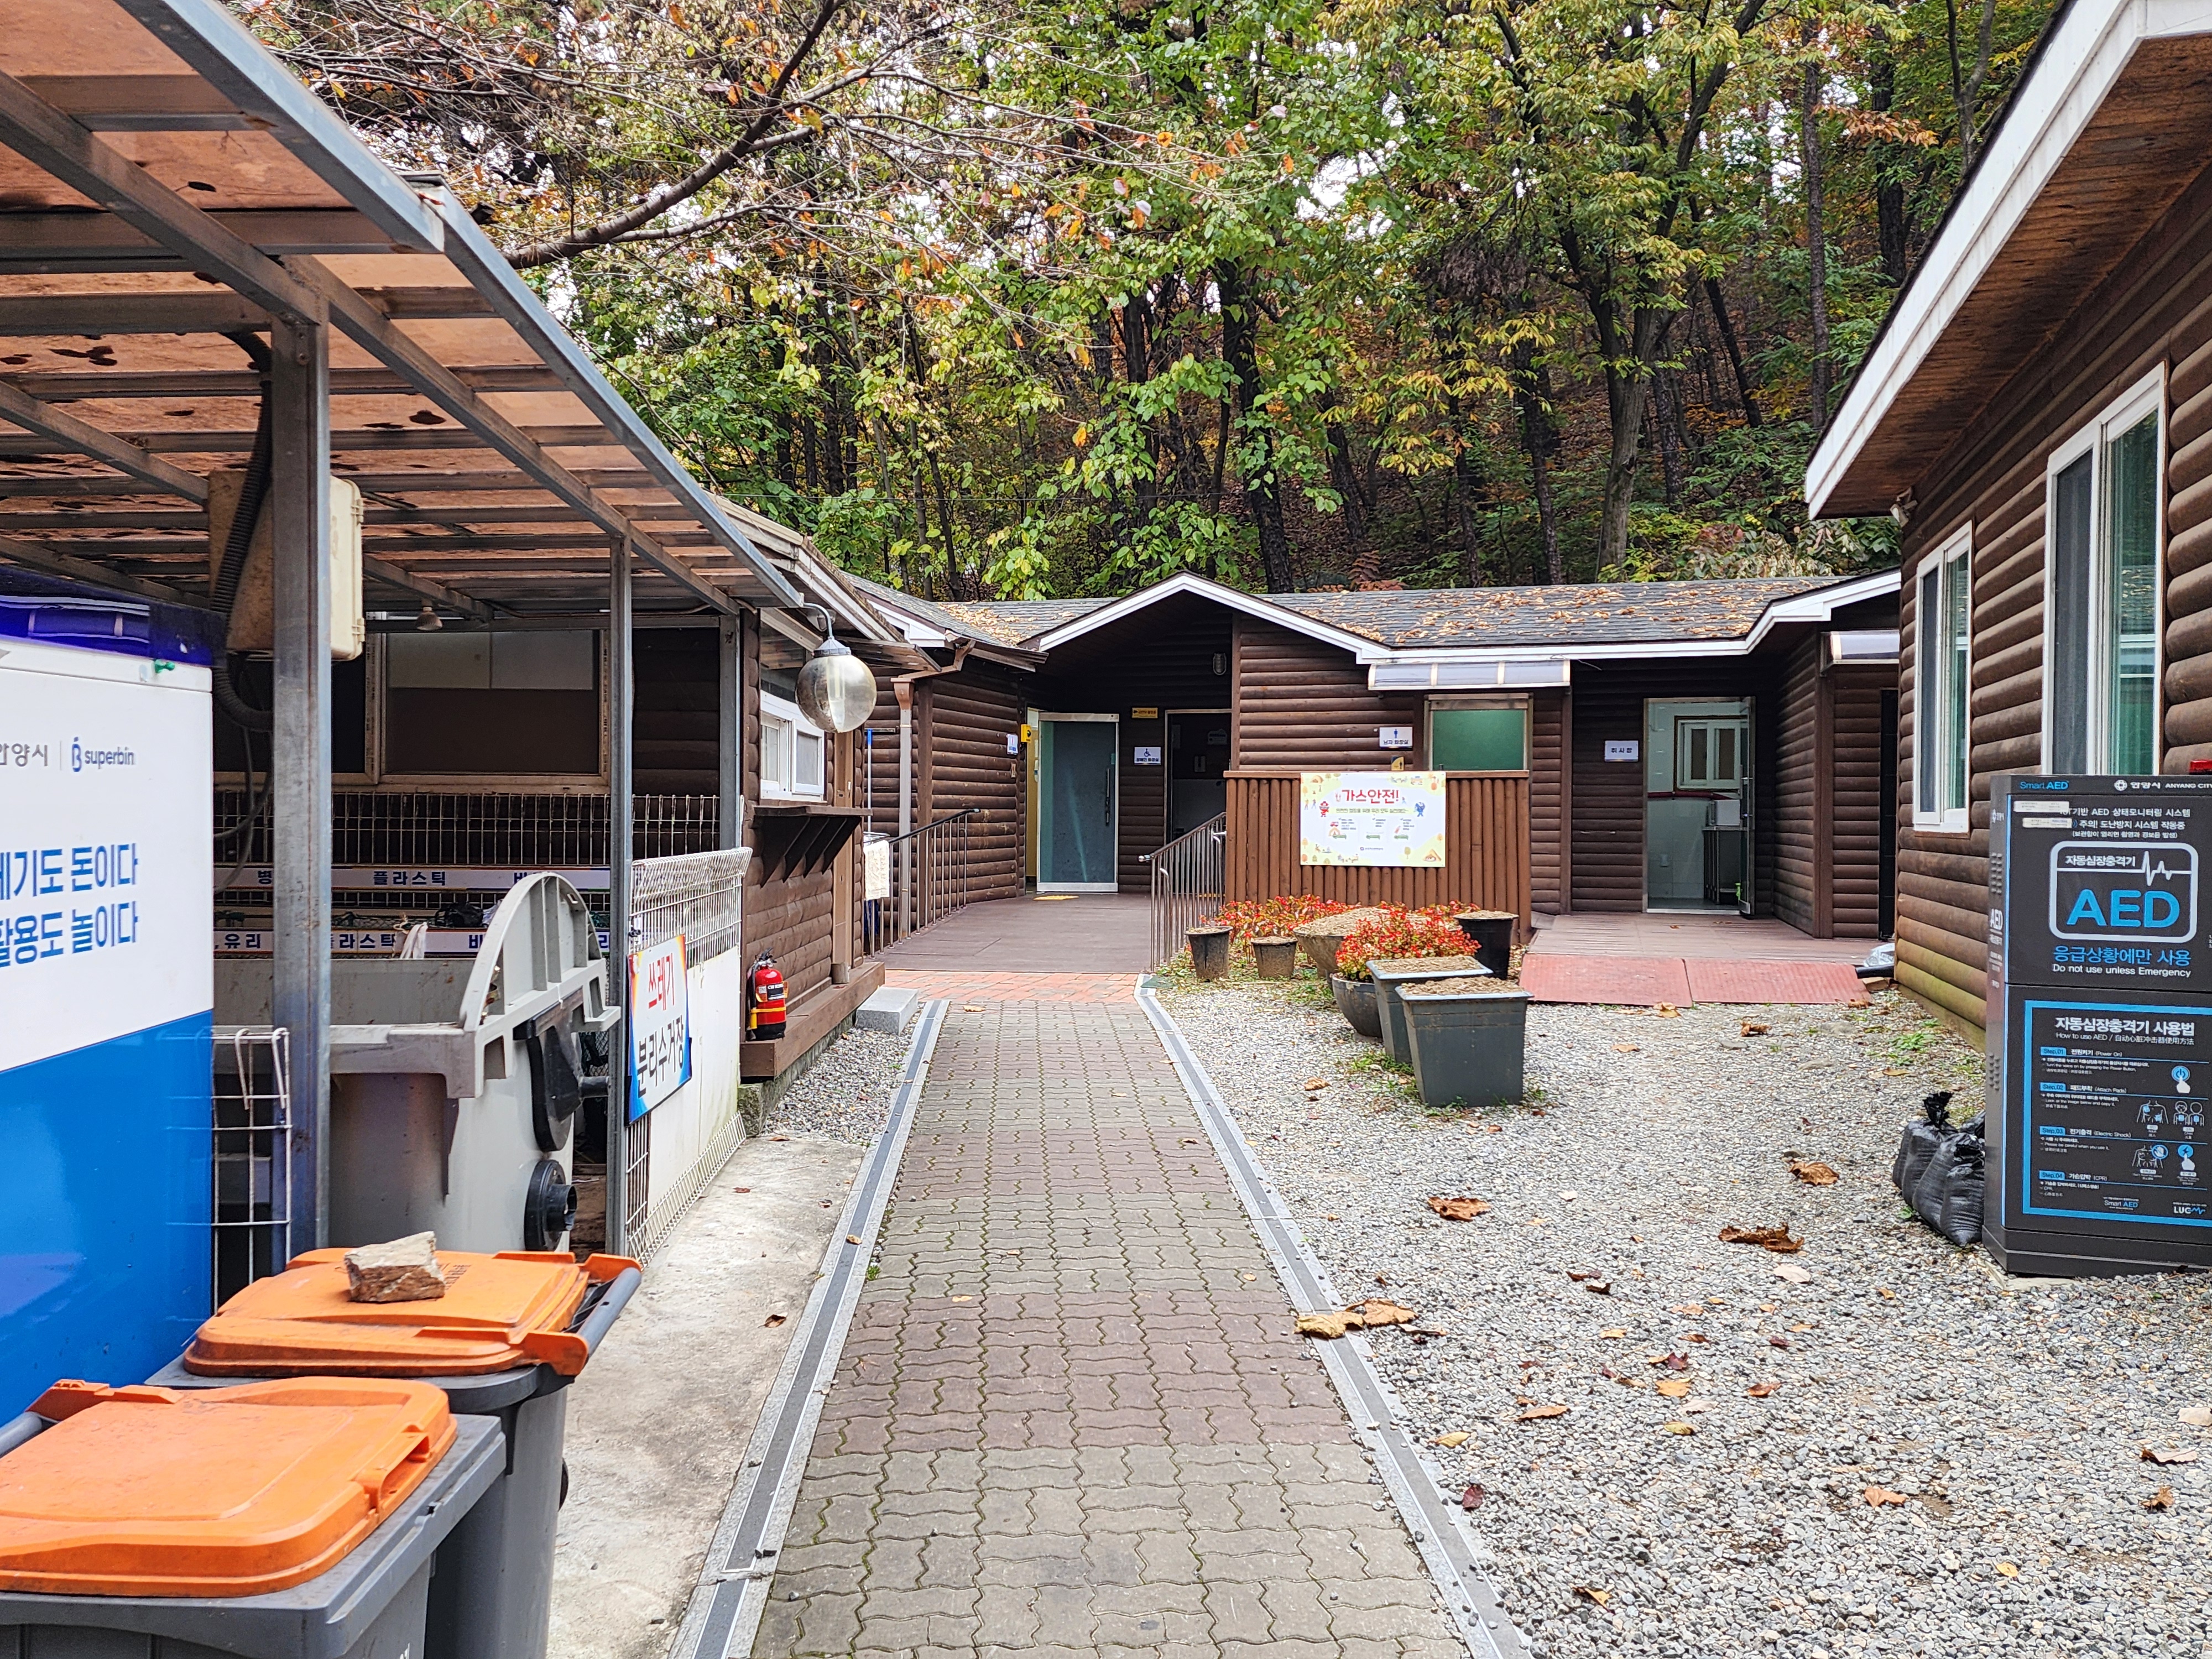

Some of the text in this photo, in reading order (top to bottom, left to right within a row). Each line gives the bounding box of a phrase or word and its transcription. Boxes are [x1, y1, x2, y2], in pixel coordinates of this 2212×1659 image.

[85, 747, 134, 769] superbin
[1341, 789, 1399, 804] 가스안전!
[2112, 808, 2162, 817] 상태모니터링
[2165, 808, 2191, 817] 시스템
[2079, 820, 2185, 830] 주의! 도난방지 시스템 작동중
[71, 843, 138, 892] 돈이다
[2065, 854, 2136, 867] 자동심장충격기
[373, 870, 446, 886] 플라스틱
[2067, 888, 2180, 928] AED
[71, 901, 138, 954] 놀이다
[1990, 908, 2004, 931] AED
[330, 933, 396, 949] 라스틱
[2053, 945, 2192, 966] 응급상황에만 사용
[2052, 963, 2067, 973] Do
[2069, 963, 2083, 973] not
[2105, 965, 2136, 975] unless
[2138, 967, 2192, 978] Emergency
[648, 952, 675, 1011] 쓰레기
[2055, 1017, 2195, 1037] 자동심장충격기 사용법
[637, 1014, 684, 1099] 분리수거장
